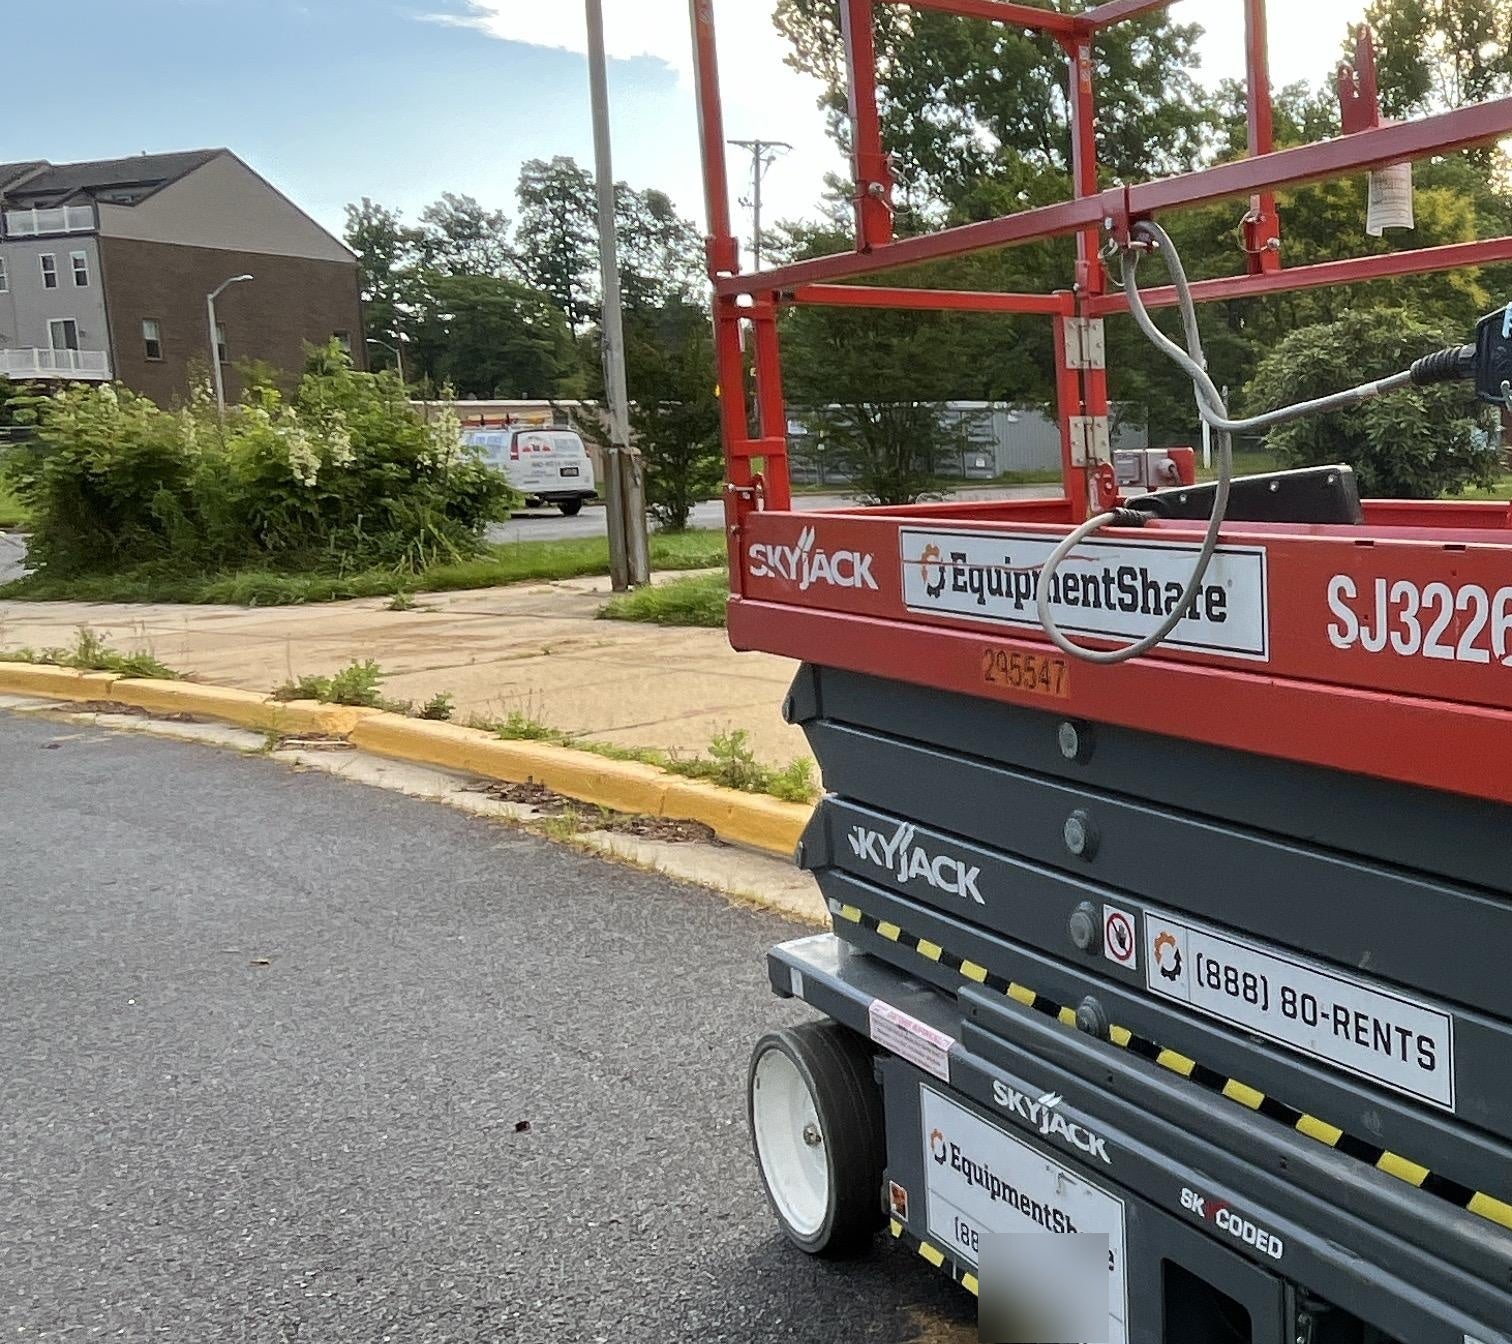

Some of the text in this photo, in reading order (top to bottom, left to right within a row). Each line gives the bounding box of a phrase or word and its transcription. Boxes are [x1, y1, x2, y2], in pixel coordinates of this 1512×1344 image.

[748, 525, 879, 591] SKYJACK
[949, 551, 1228, 623] EquipmentShare
[985, 648, 1065, 694] 295547
[1196, 952, 1436, 1072] (888) 80-RENTS
[992, 1079, 1113, 1165] SKYJACK
